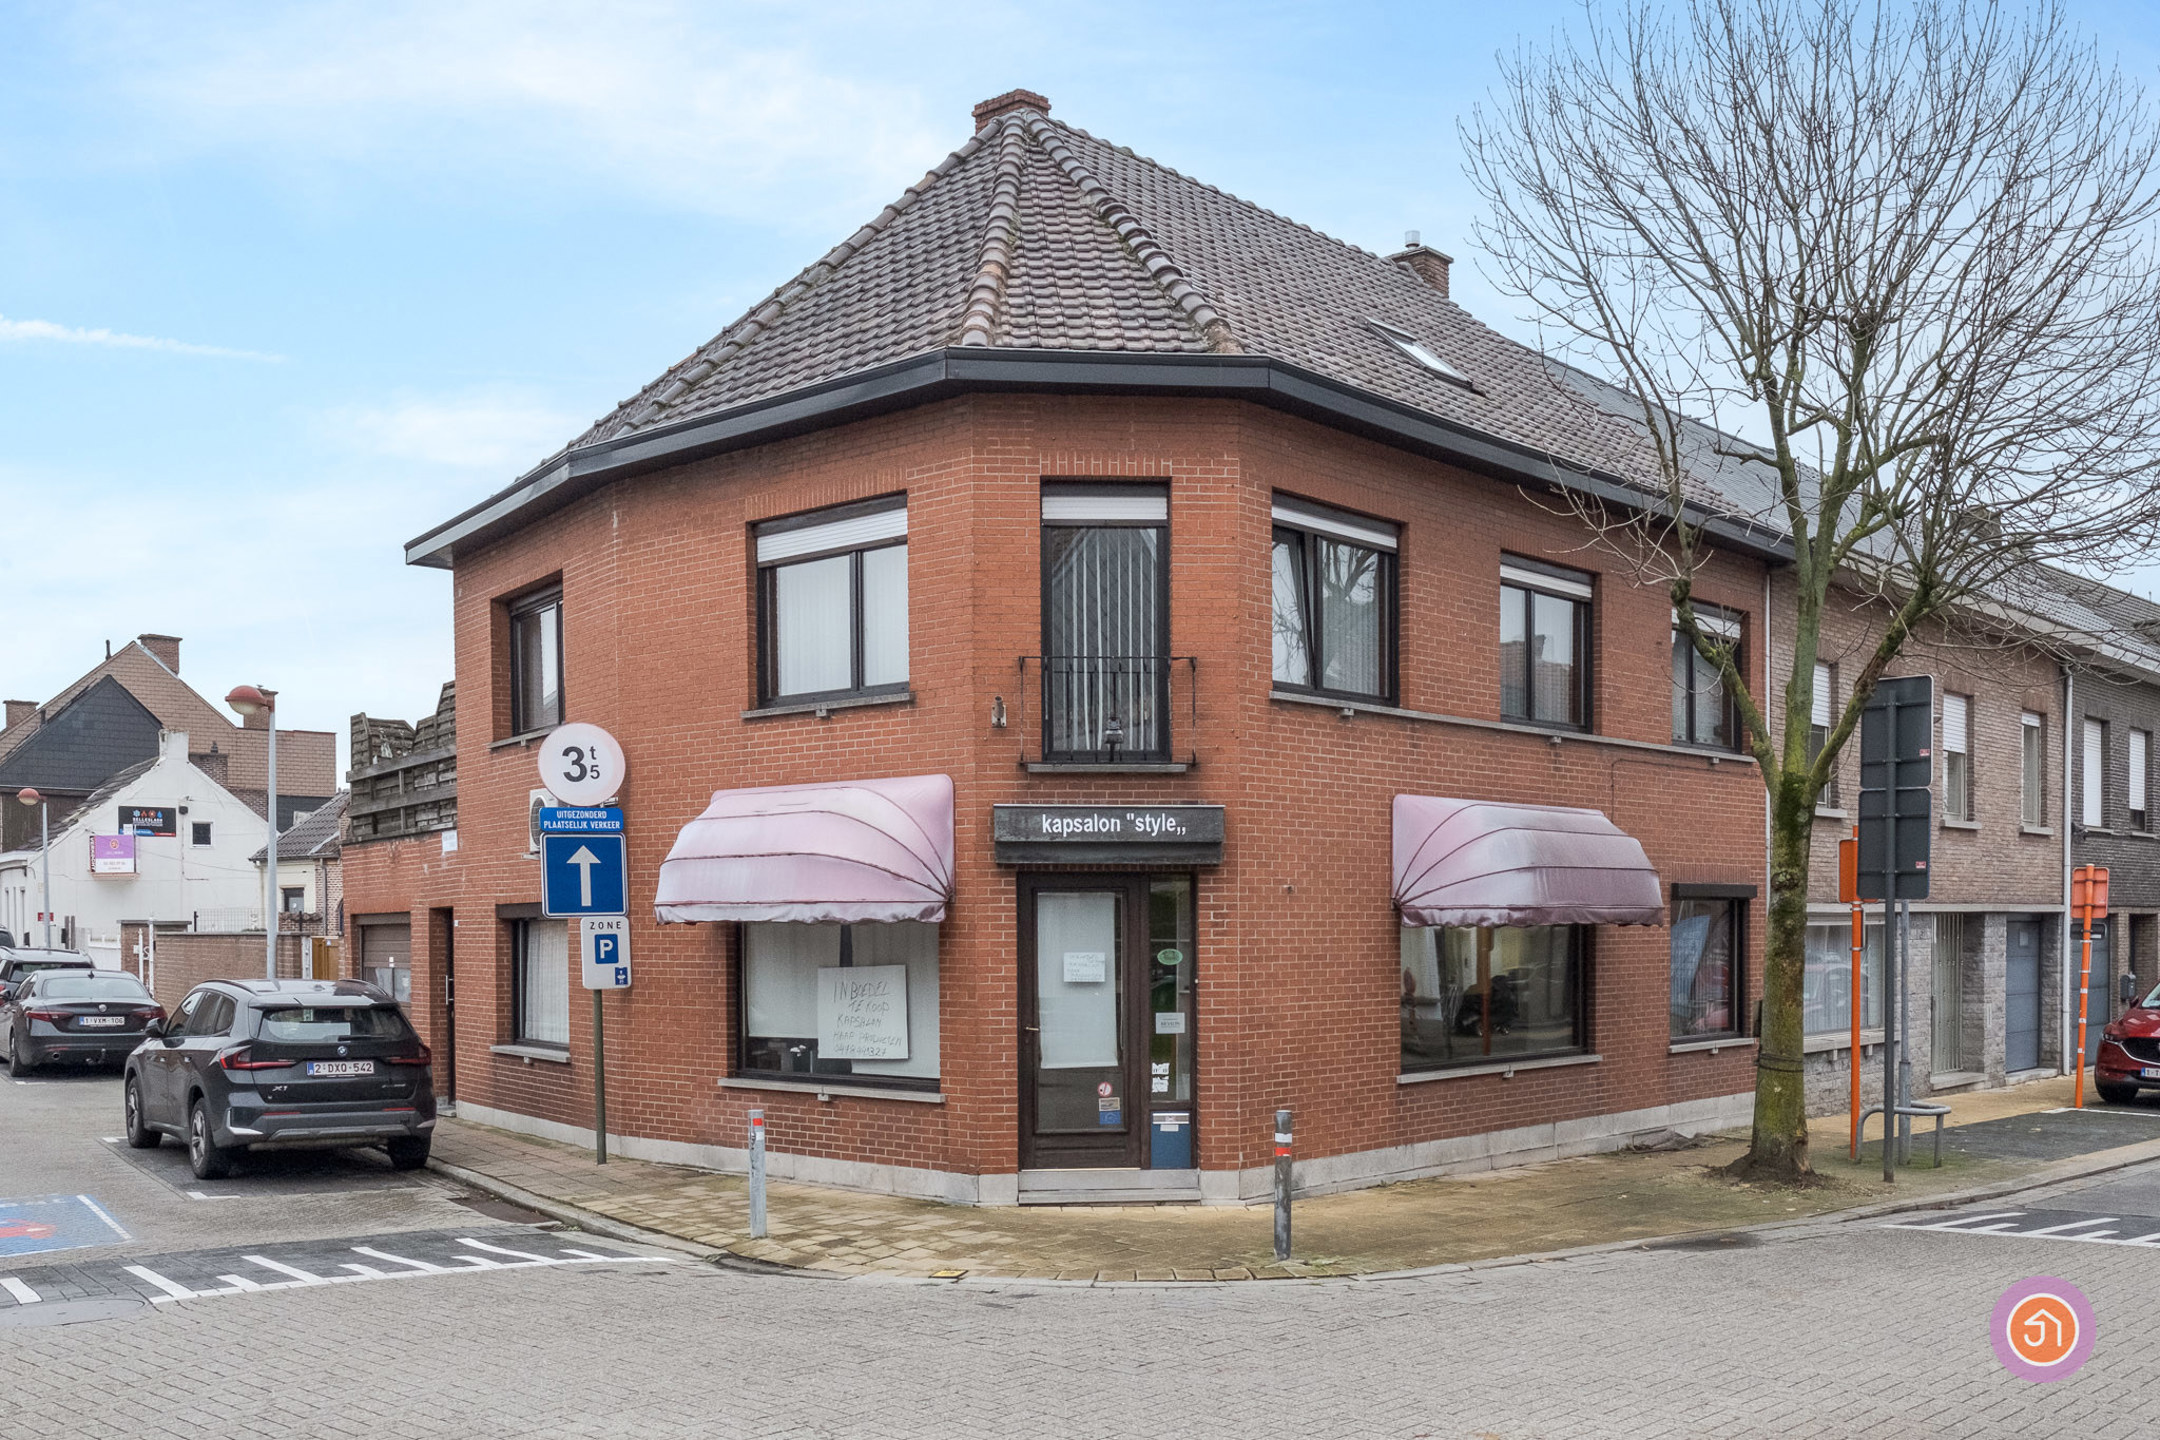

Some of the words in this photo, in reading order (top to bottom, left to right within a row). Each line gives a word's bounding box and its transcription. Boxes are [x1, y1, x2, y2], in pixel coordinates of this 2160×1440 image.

[562, 746, 587, 782] 3
[590, 764, 600, 779] 5
[556, 810, 607, 819] UITGEZONDERD
[543, 820, 588, 829] PLAATSELIJK
[590, 821, 620, 829] VERKEER
[1042, 813, 1121, 837] kapsalon
[589, 921, 622, 930] ZONE
[600, 939, 613, 959] P
[848, 1000, 864, 1013] TE
